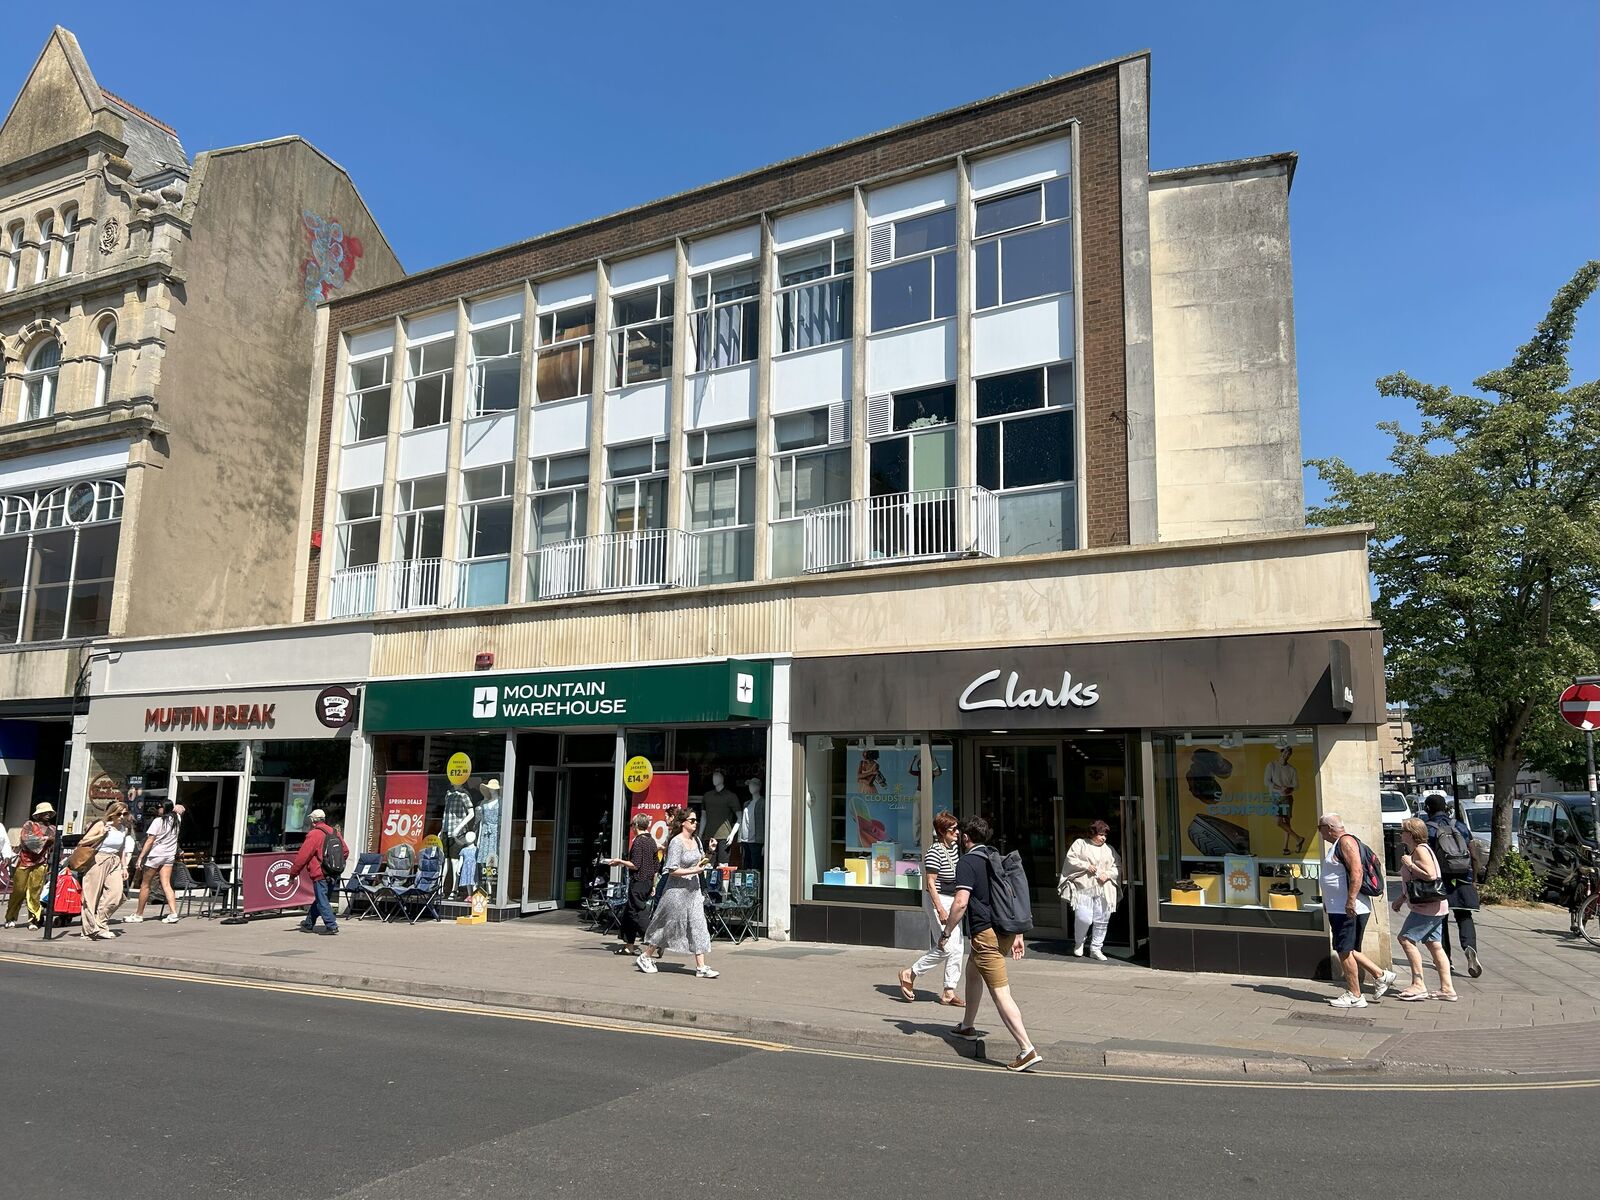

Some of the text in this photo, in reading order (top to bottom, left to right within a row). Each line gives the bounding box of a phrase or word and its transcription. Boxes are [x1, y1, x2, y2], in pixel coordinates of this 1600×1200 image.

[503, 681, 606, 700] MOUNTAIN
[958, 669, 1100, 710] Clarks
[144, 703, 276, 730] MUFFIN BREAK
[502, 699, 627, 717] WAREHOUSE
[627, 774, 649, 783] £14.99
[1213, 791, 1281, 802] SUMMER
[1206, 803, 1290, 816] COMFORT
[384, 813, 424, 836] 50%
[1232, 876, 1247, 886] £45
